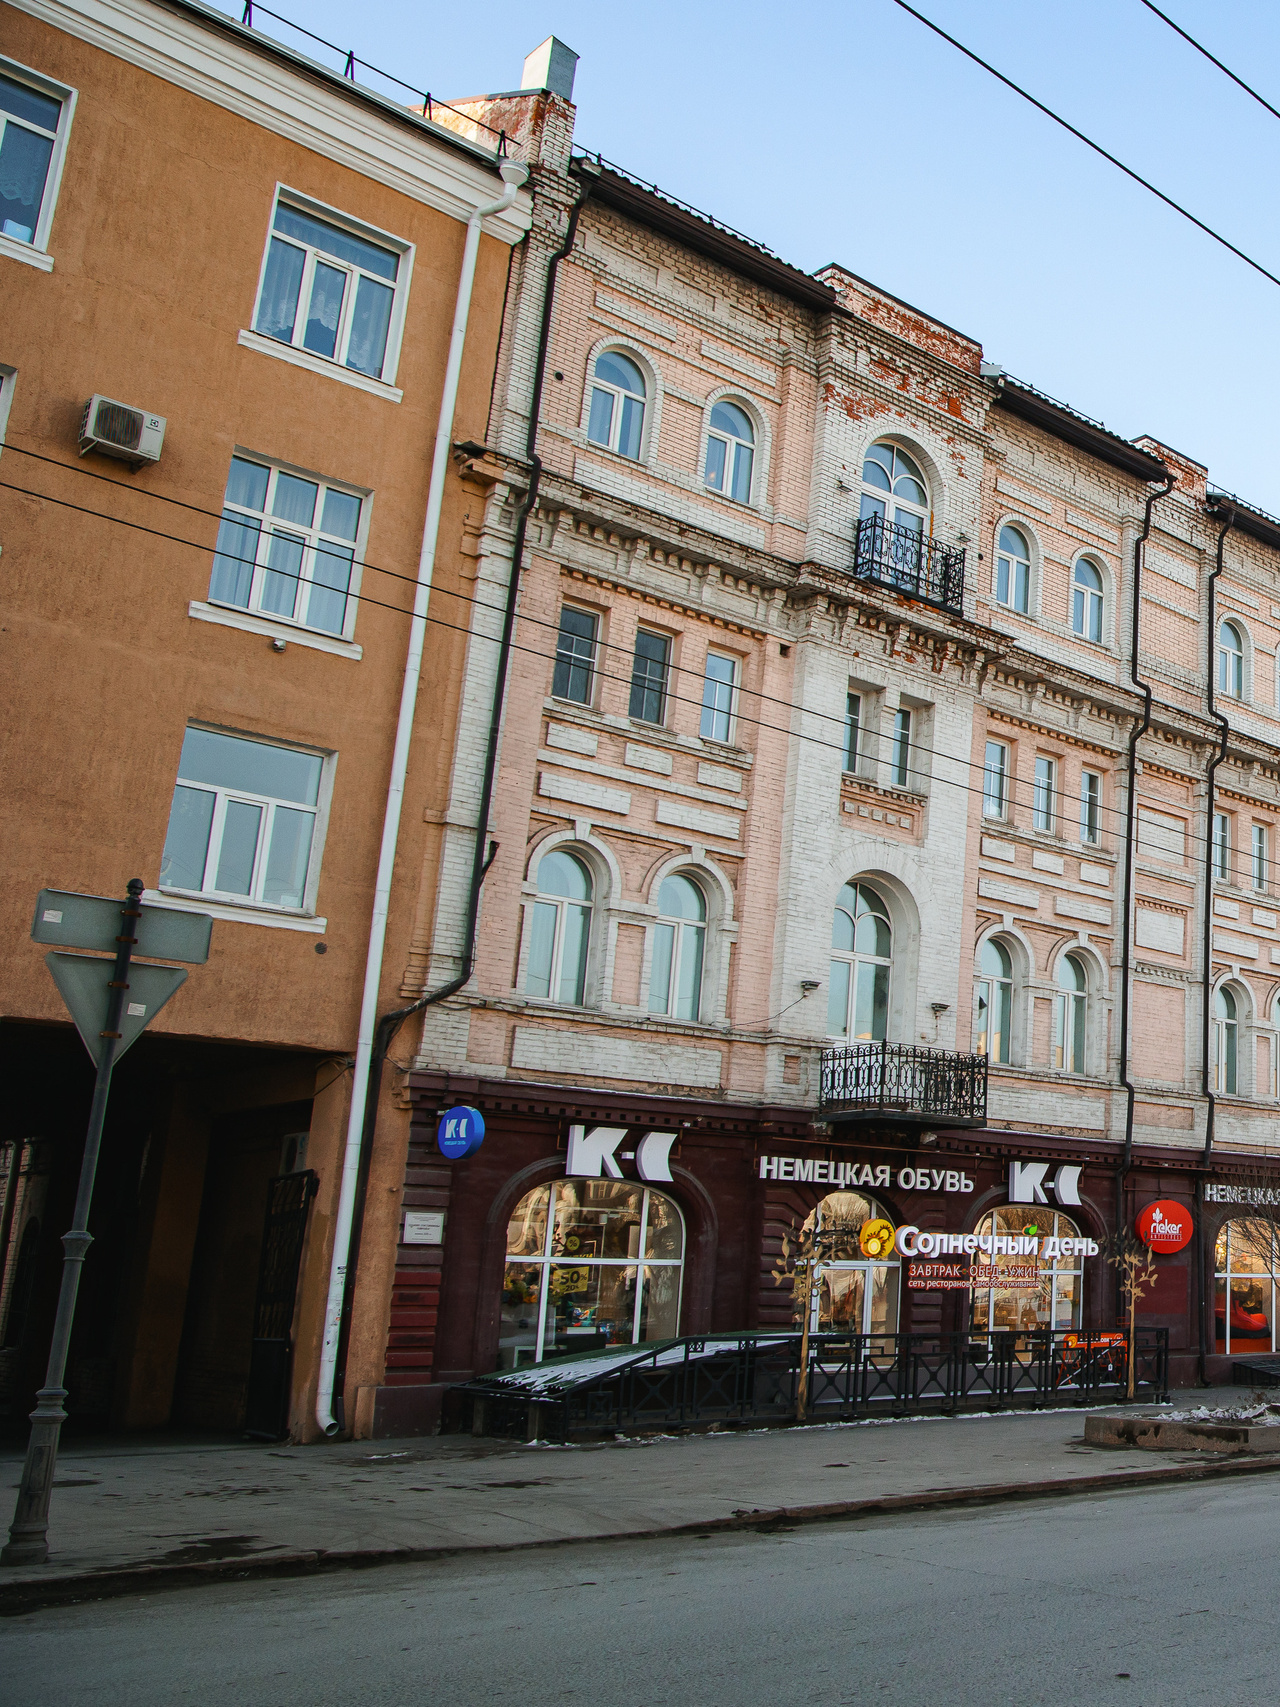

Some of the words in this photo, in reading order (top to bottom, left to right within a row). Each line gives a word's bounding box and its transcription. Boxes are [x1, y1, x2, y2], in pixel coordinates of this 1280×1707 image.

[759, 1155, 890, 1189] НЕМЕЦКАЯ
[897, 1167, 974, 1193] ОБУВЬ
[1151, 1218, 1182, 1234] rieker
[896, 1225, 1038, 1258] Солнечный
[1040, 1236, 1099, 1259] день
[909, 1265, 960, 1277] ЗАВТРАК
[969, 1265, 999, 1278] ОБЕД
[1007, 1265, 1040, 1277] УЖИН
[908, 1280, 925, 1289] сеть
[927, 1281, 970, 1290] ресторанов
[971, 1280, 1040, 1291] самообслуживания
